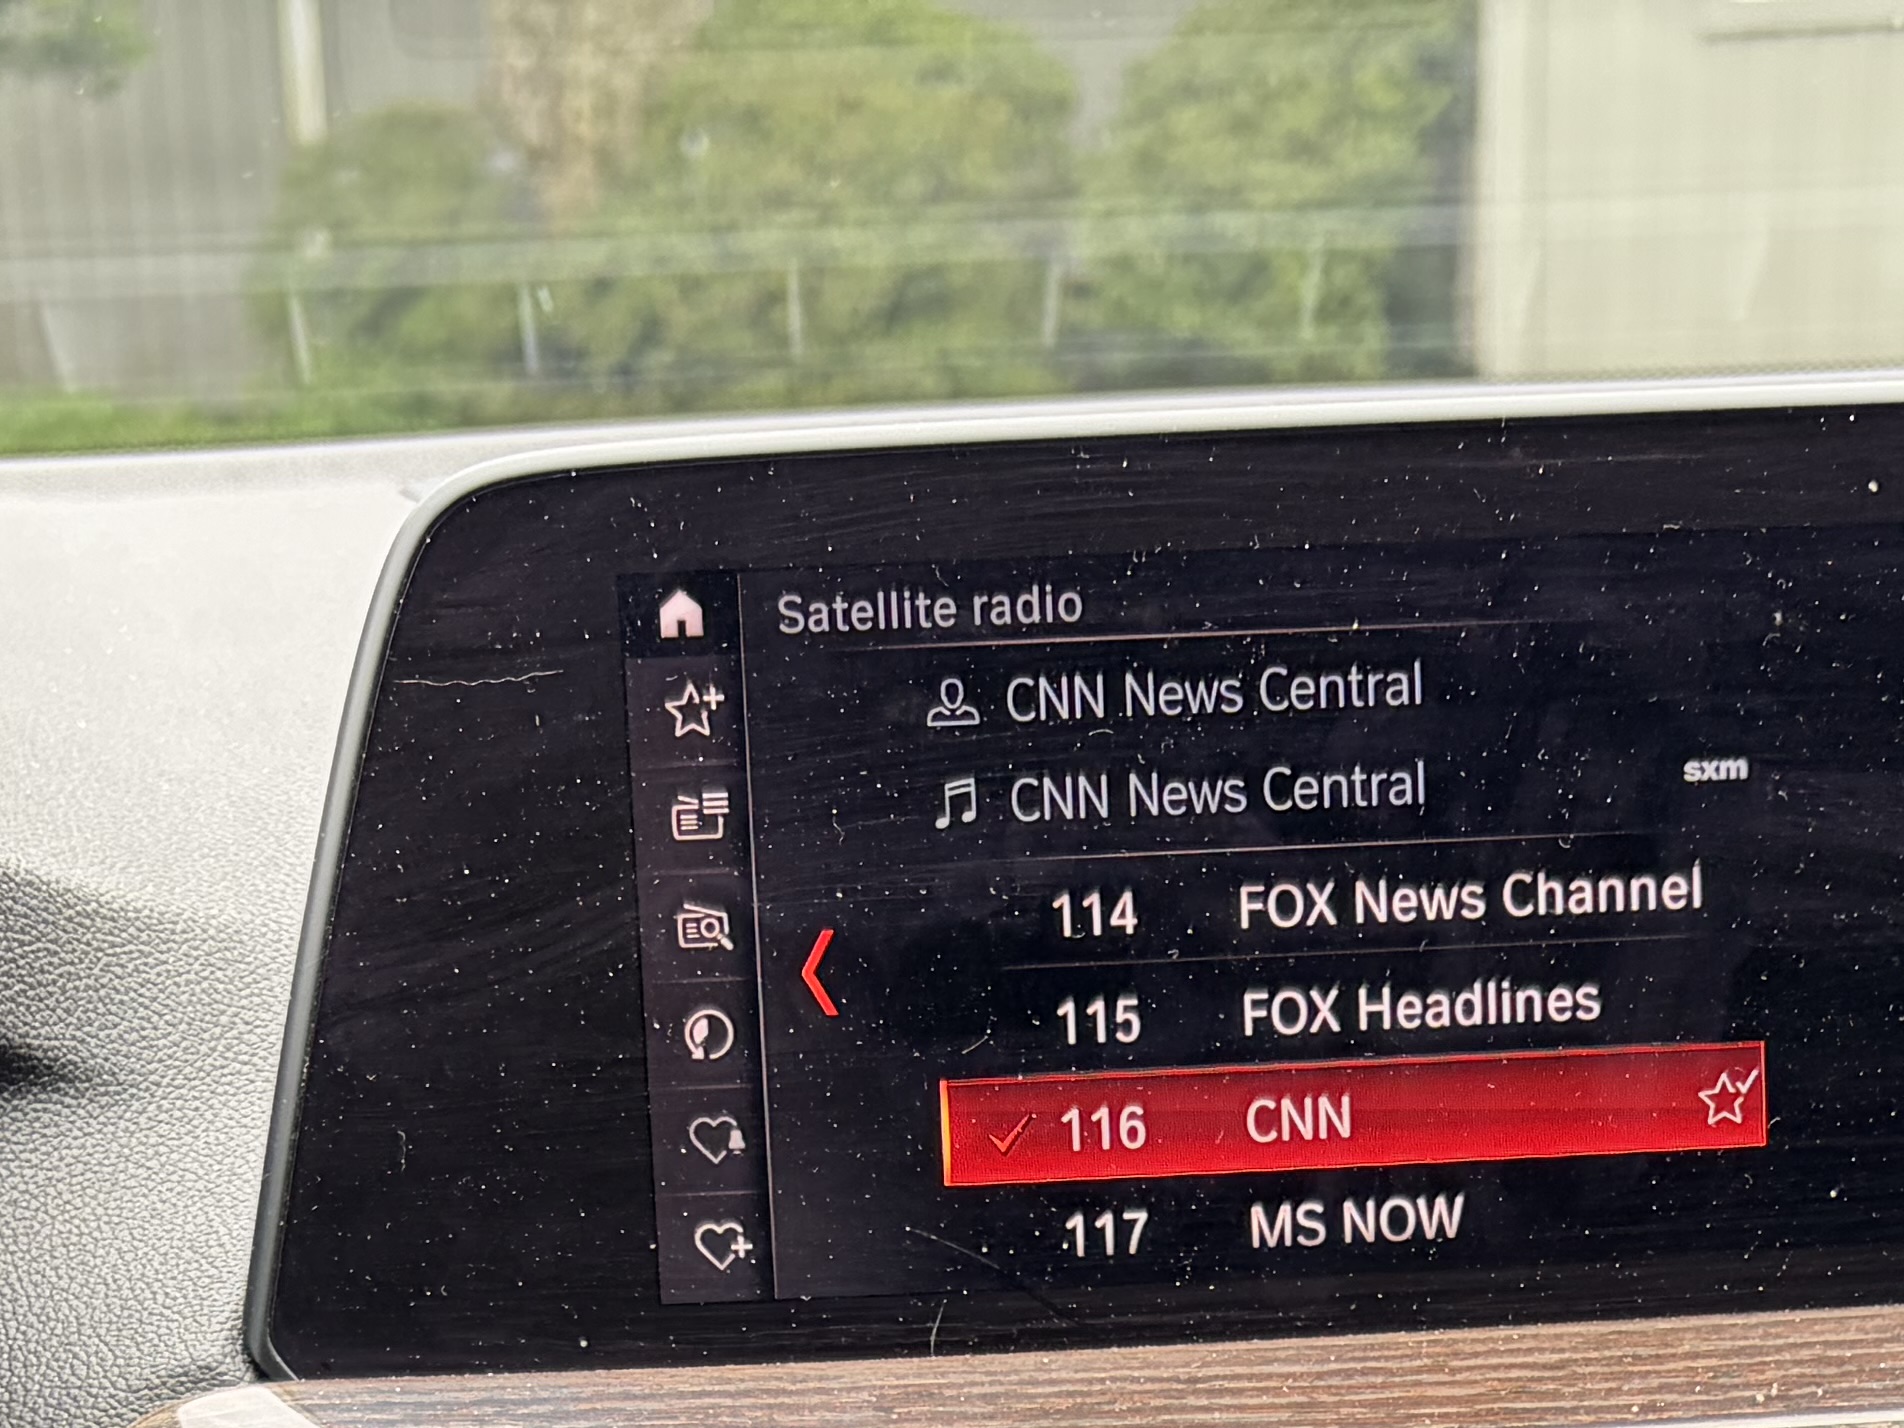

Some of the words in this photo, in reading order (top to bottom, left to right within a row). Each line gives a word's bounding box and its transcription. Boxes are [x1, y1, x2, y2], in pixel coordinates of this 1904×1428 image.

[777, 591, 958, 635] Satellite
[972, 586, 1083, 628] radio
[1007, 673, 1105, 723] CNN
[1124, 669, 1244, 716] News
[1258, 660, 1423, 711] Central
[1010, 772, 1109, 821] CNN
[1128, 768, 1248, 815] News
[1263, 758, 1427, 811] Central
[1683, 756, 1748, 784] sxm
[1051, 893, 1139, 938] 114
[1238, 882, 1336, 931] FOX
[1354, 876, 1486, 923] News
[1502, 863, 1703, 916] Channel
[1055, 999, 1142, 1045] 115
[1243, 989, 1340, 1037] FOX
[1358, 981, 1600, 1031] Headlines
[1061, 1105, 1146, 1153] 116
[1246, 1095, 1352, 1144] CNN
[1064, 1211, 1149, 1258] 117
[1249, 1202, 1326, 1249] MS
[1344, 1196, 1464, 1243] NOW
